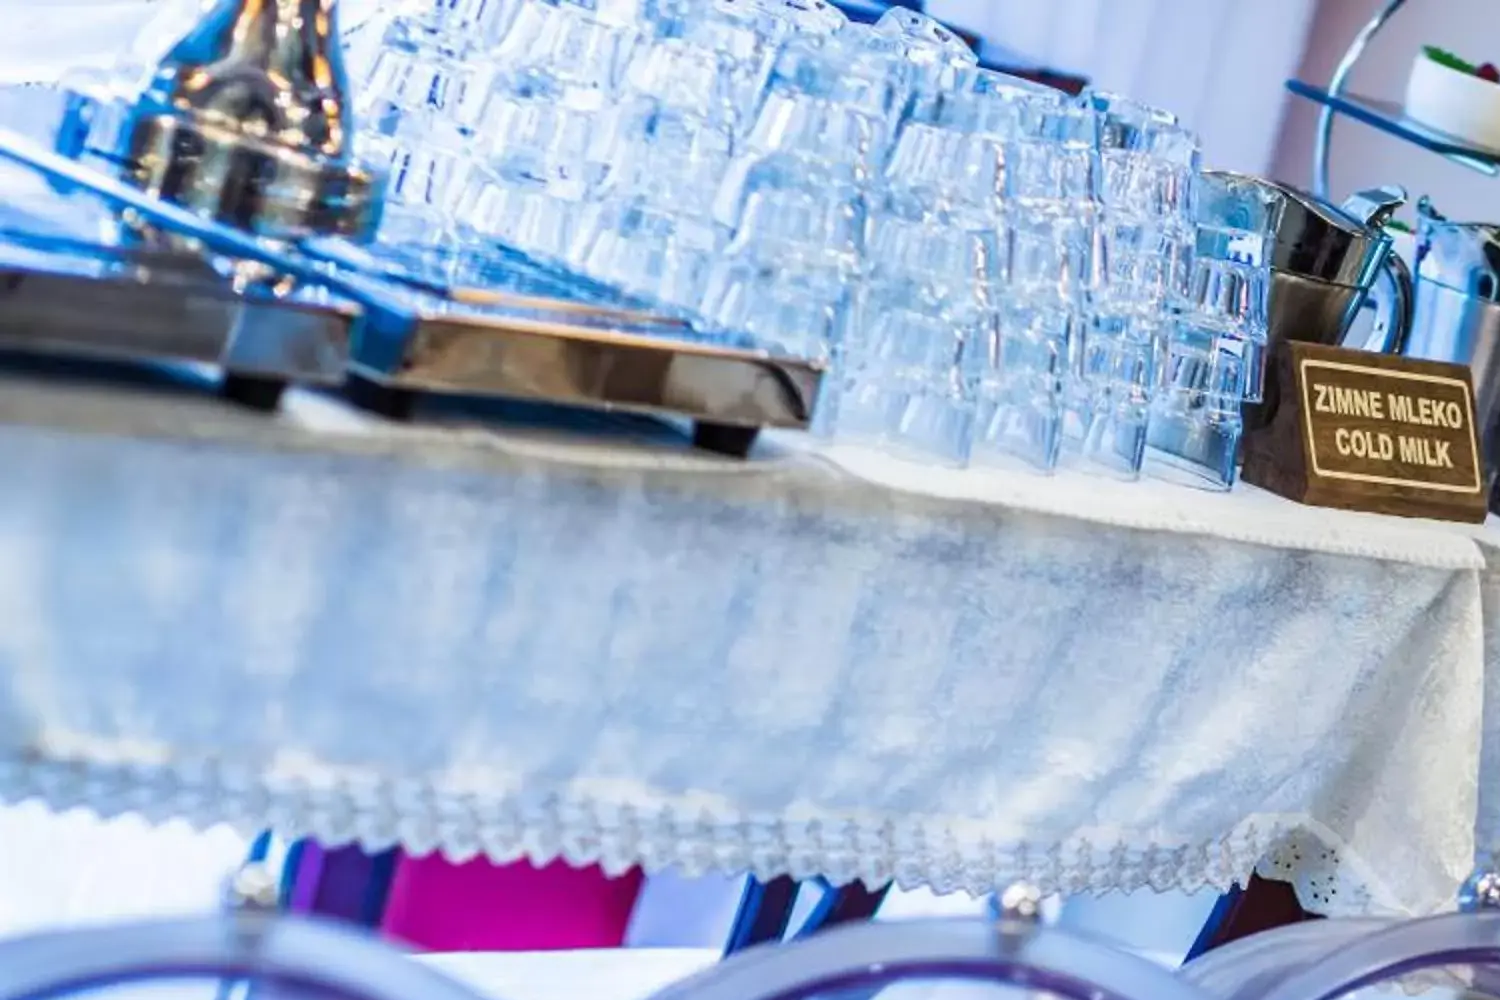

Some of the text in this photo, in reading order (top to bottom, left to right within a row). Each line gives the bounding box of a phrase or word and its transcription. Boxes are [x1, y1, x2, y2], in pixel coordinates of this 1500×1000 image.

[1314, 383, 1462, 429] ZIMNE MLEKO
[1335, 428, 1454, 468] COLD MILK
